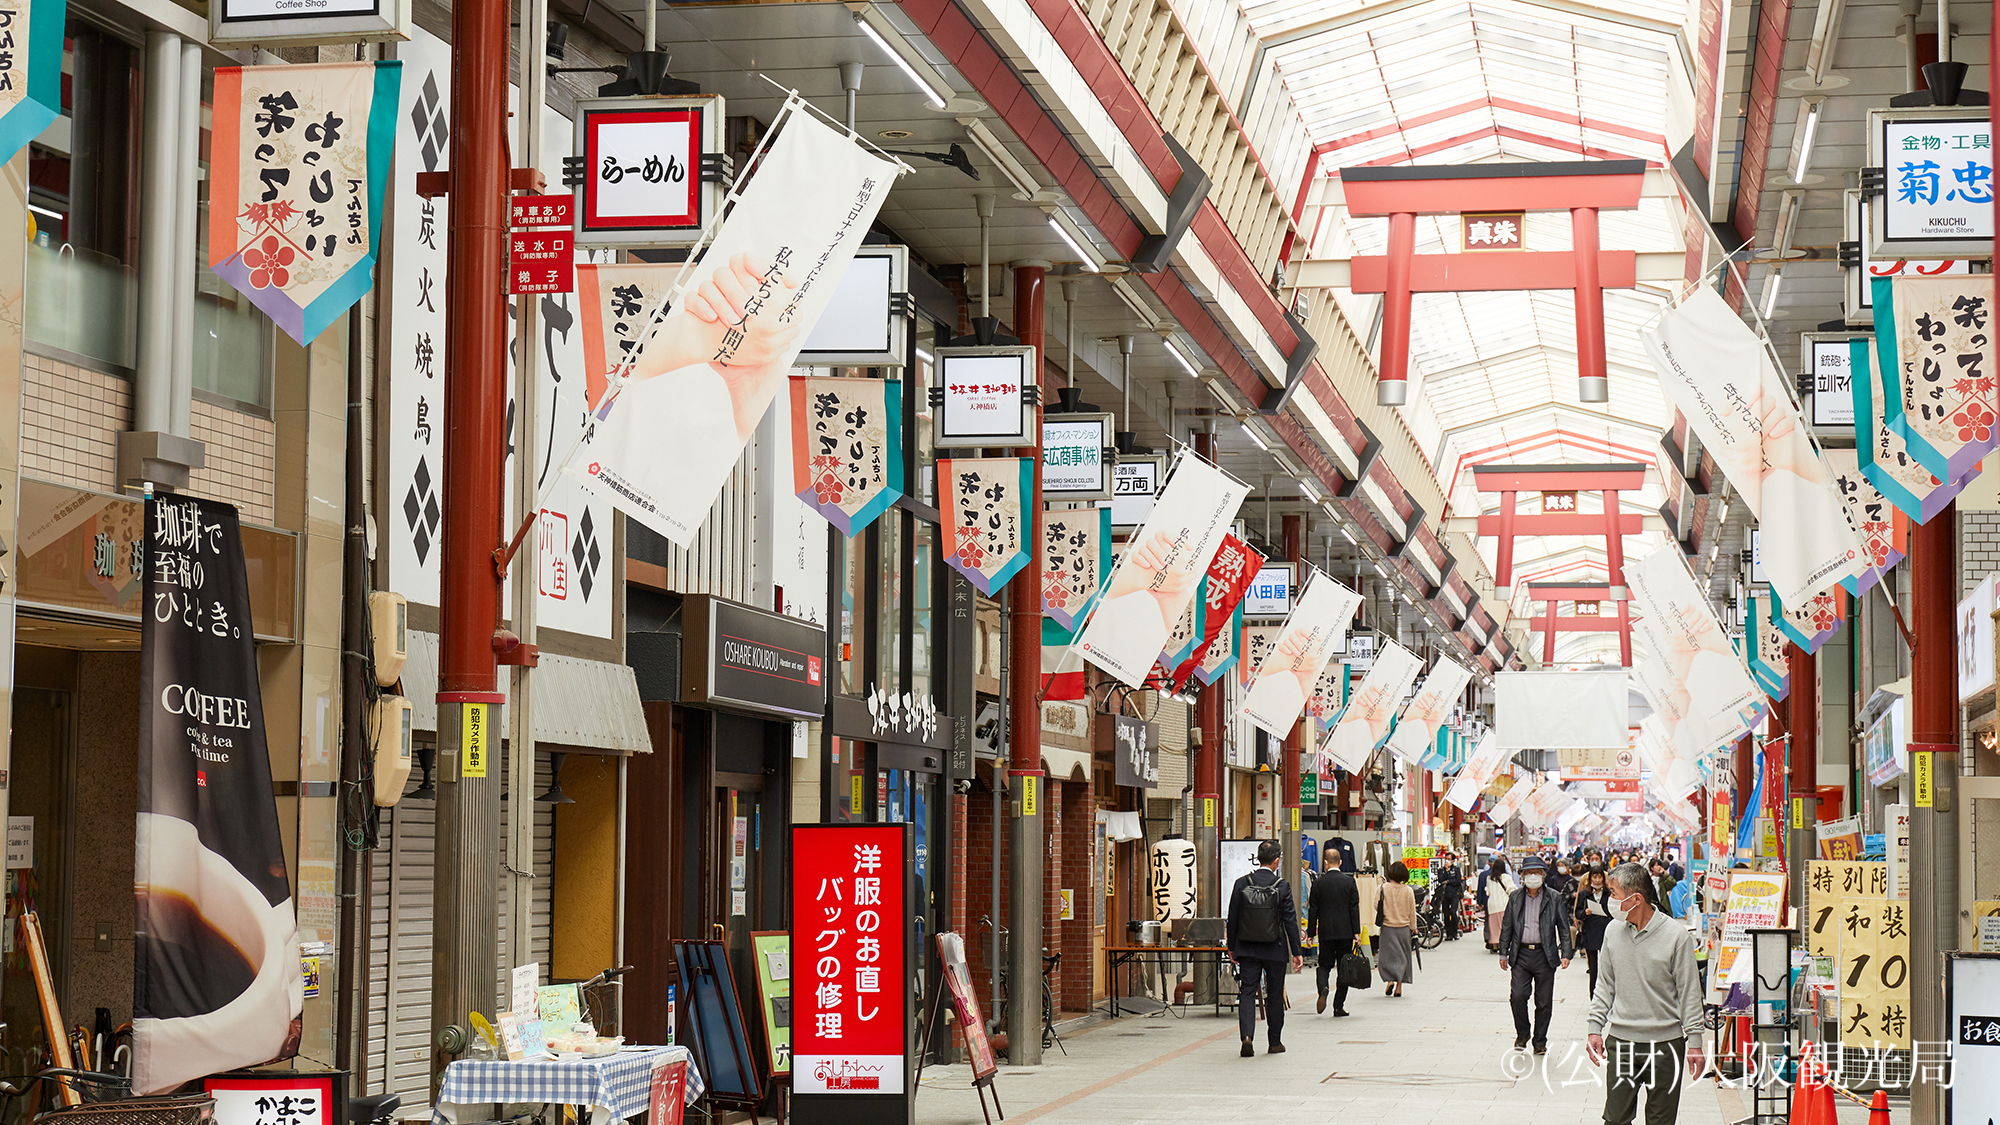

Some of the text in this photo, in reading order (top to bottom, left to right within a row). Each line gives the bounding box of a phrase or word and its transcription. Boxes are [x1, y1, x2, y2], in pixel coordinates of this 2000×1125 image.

[275, 0, 327, 9] Coffee Shop
[1901, 134, 1991, 151] 金物・工具
[601, 154, 685, 184] らーめん
[1896, 159, 1993, 206] 菊忠
[513, 205, 567, 217] 滑車あり
[1468, 220, 1518, 246] 真朱
[1921, 226, 1975, 234] Hardware Store
[1928, 216, 1967, 226] KIKUCHU
[778, 177, 876, 324] 新型コロナウイルスに負けない
[412, 201, 437, 446] 炭火焼鳥
[713, 245, 794, 368] 私たちは人間だ
[1952, 295, 1989, 377] 笑って
[1904, 361, 1915, 411] てんさん
[1915, 313, 1947, 421] わっしょい
[969, 402, 997, 411] 天神橋店
[153, 496, 223, 554] 珈琲で
[153, 550, 205, 590] 至福の
[1149, 527, 1191, 593] 私たちは人間だ
[1206, 544, 1246, 610] 熟成
[1247, 584, 1286, 599] 八田屋
[154, 592, 240, 639] ひととき。
[723, 641, 752, 666] OSHARE
[752, 647, 779, 671] KOUBOU
[201, 732, 209, 745] &
[213, 734, 233, 748] tea
[202, 748, 230, 763] time
[469, 707, 481, 768] 防犯カメラ作動中
[1918, 754, 1927, 800] 防犯カメラ作動中
[1153, 849, 1171, 925] ホルモン
[1180, 848, 1196, 918] ラーメン
[853, 844, 882, 1022] 洋服のお直し
[1845, 904, 1907, 939] 和装
[815, 877, 846, 1039] バッグの修理
[1845, 1003, 1908, 1038] 大特
